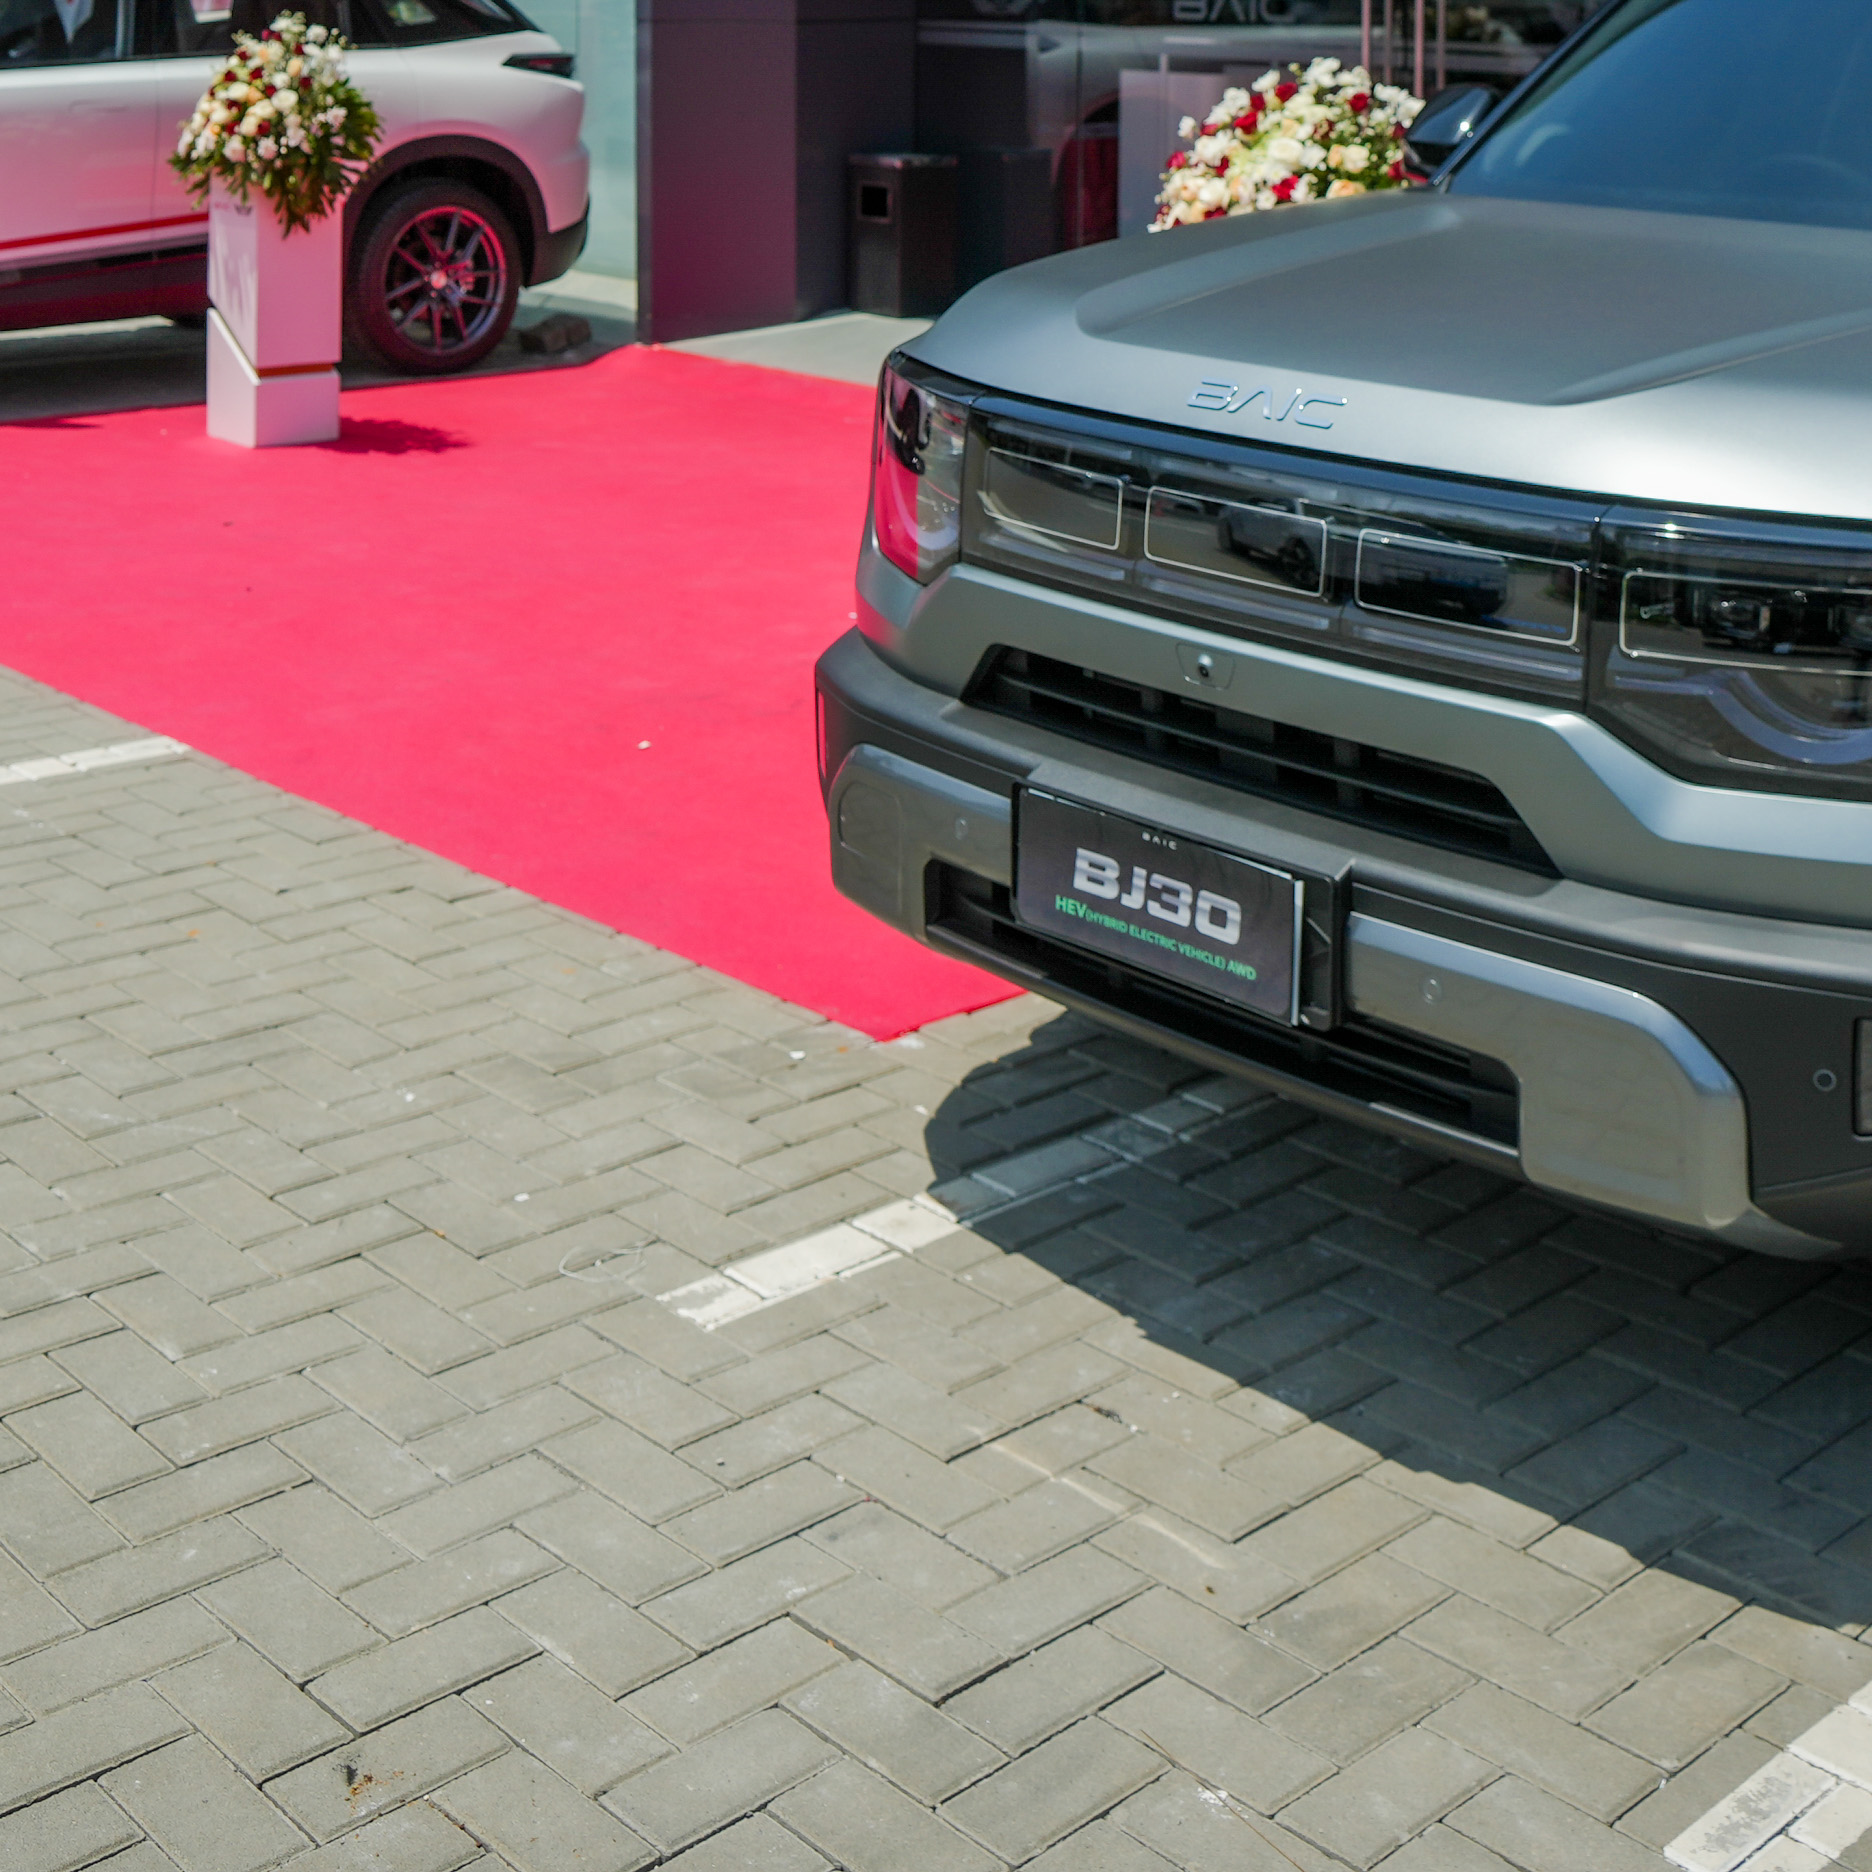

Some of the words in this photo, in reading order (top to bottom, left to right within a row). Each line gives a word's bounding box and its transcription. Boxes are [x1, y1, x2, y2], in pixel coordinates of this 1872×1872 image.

[1186, 377, 1348, 430] BAIC
[1141, 830, 1178, 851] BAIC
[1073, 846, 1242, 946] BJ30
[1128, 923, 1178, 952] ELECTRIC
[1227, 959, 1257, 981] AWD
